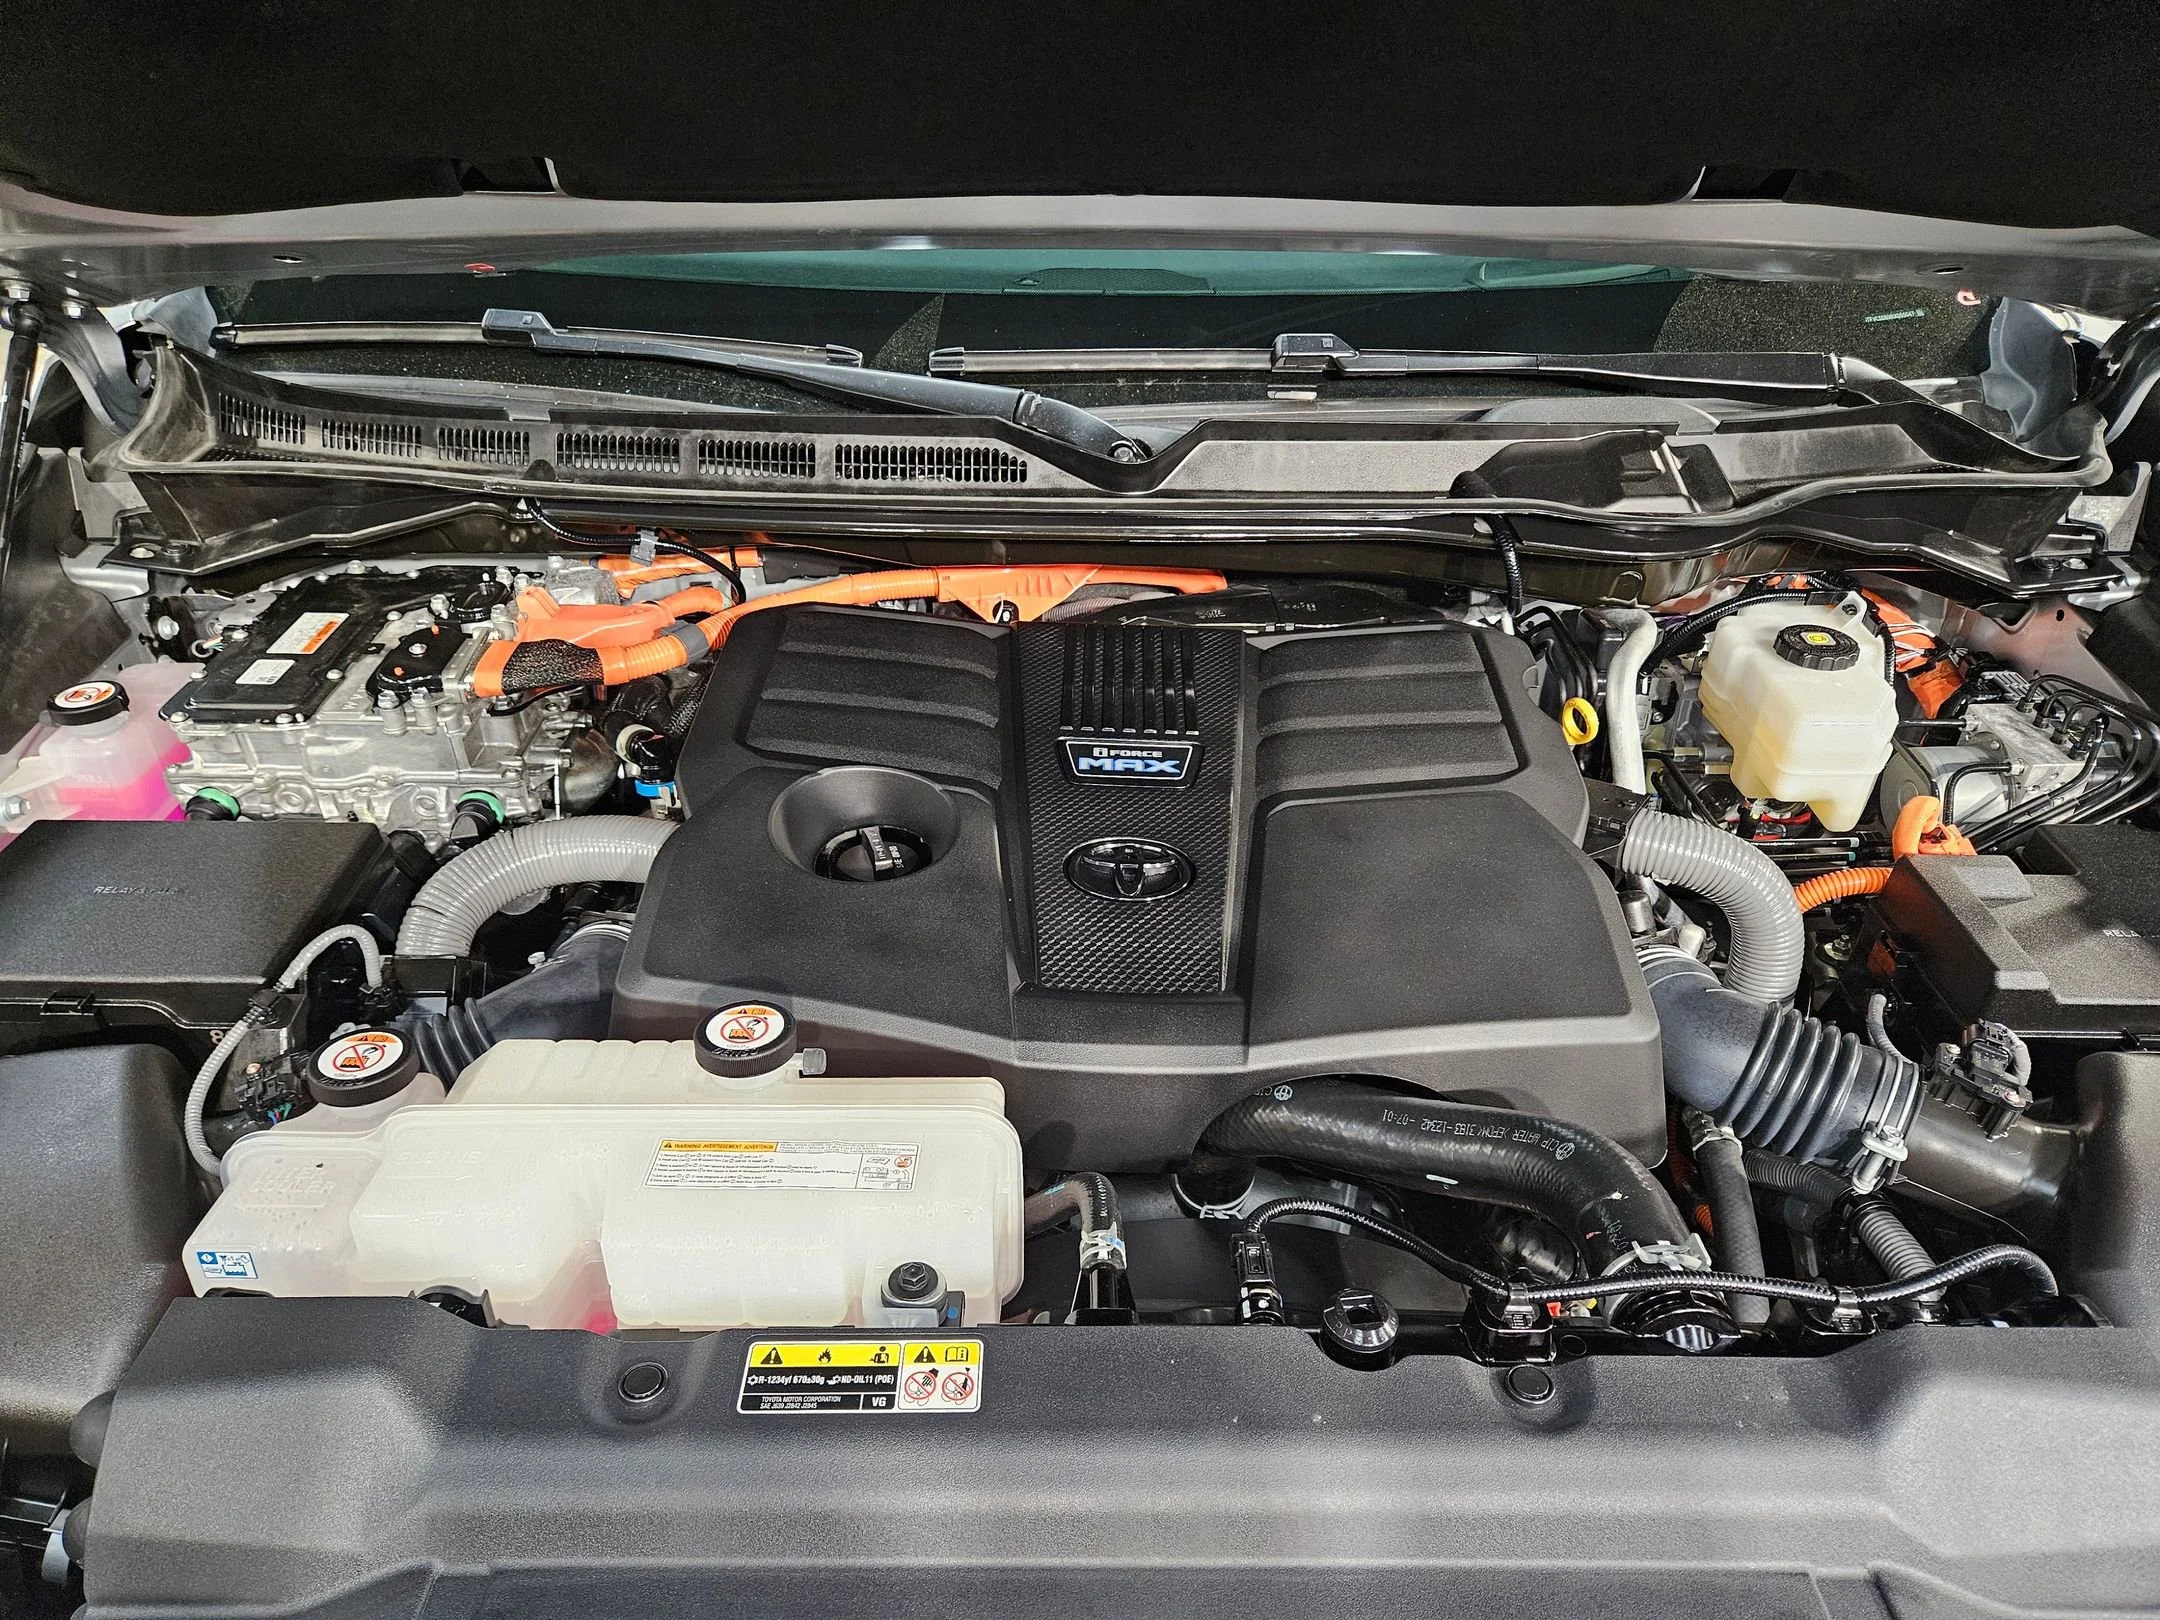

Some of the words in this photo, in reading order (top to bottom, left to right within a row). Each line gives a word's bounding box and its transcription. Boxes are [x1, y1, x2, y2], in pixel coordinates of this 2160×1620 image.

[1078, 757, 1181, 773] MAX
[1512, 1129, 1541, 1144] WATER
[875, 1375, 894, 1384] (POE)
[871, 1396, 887, 1407] VG
